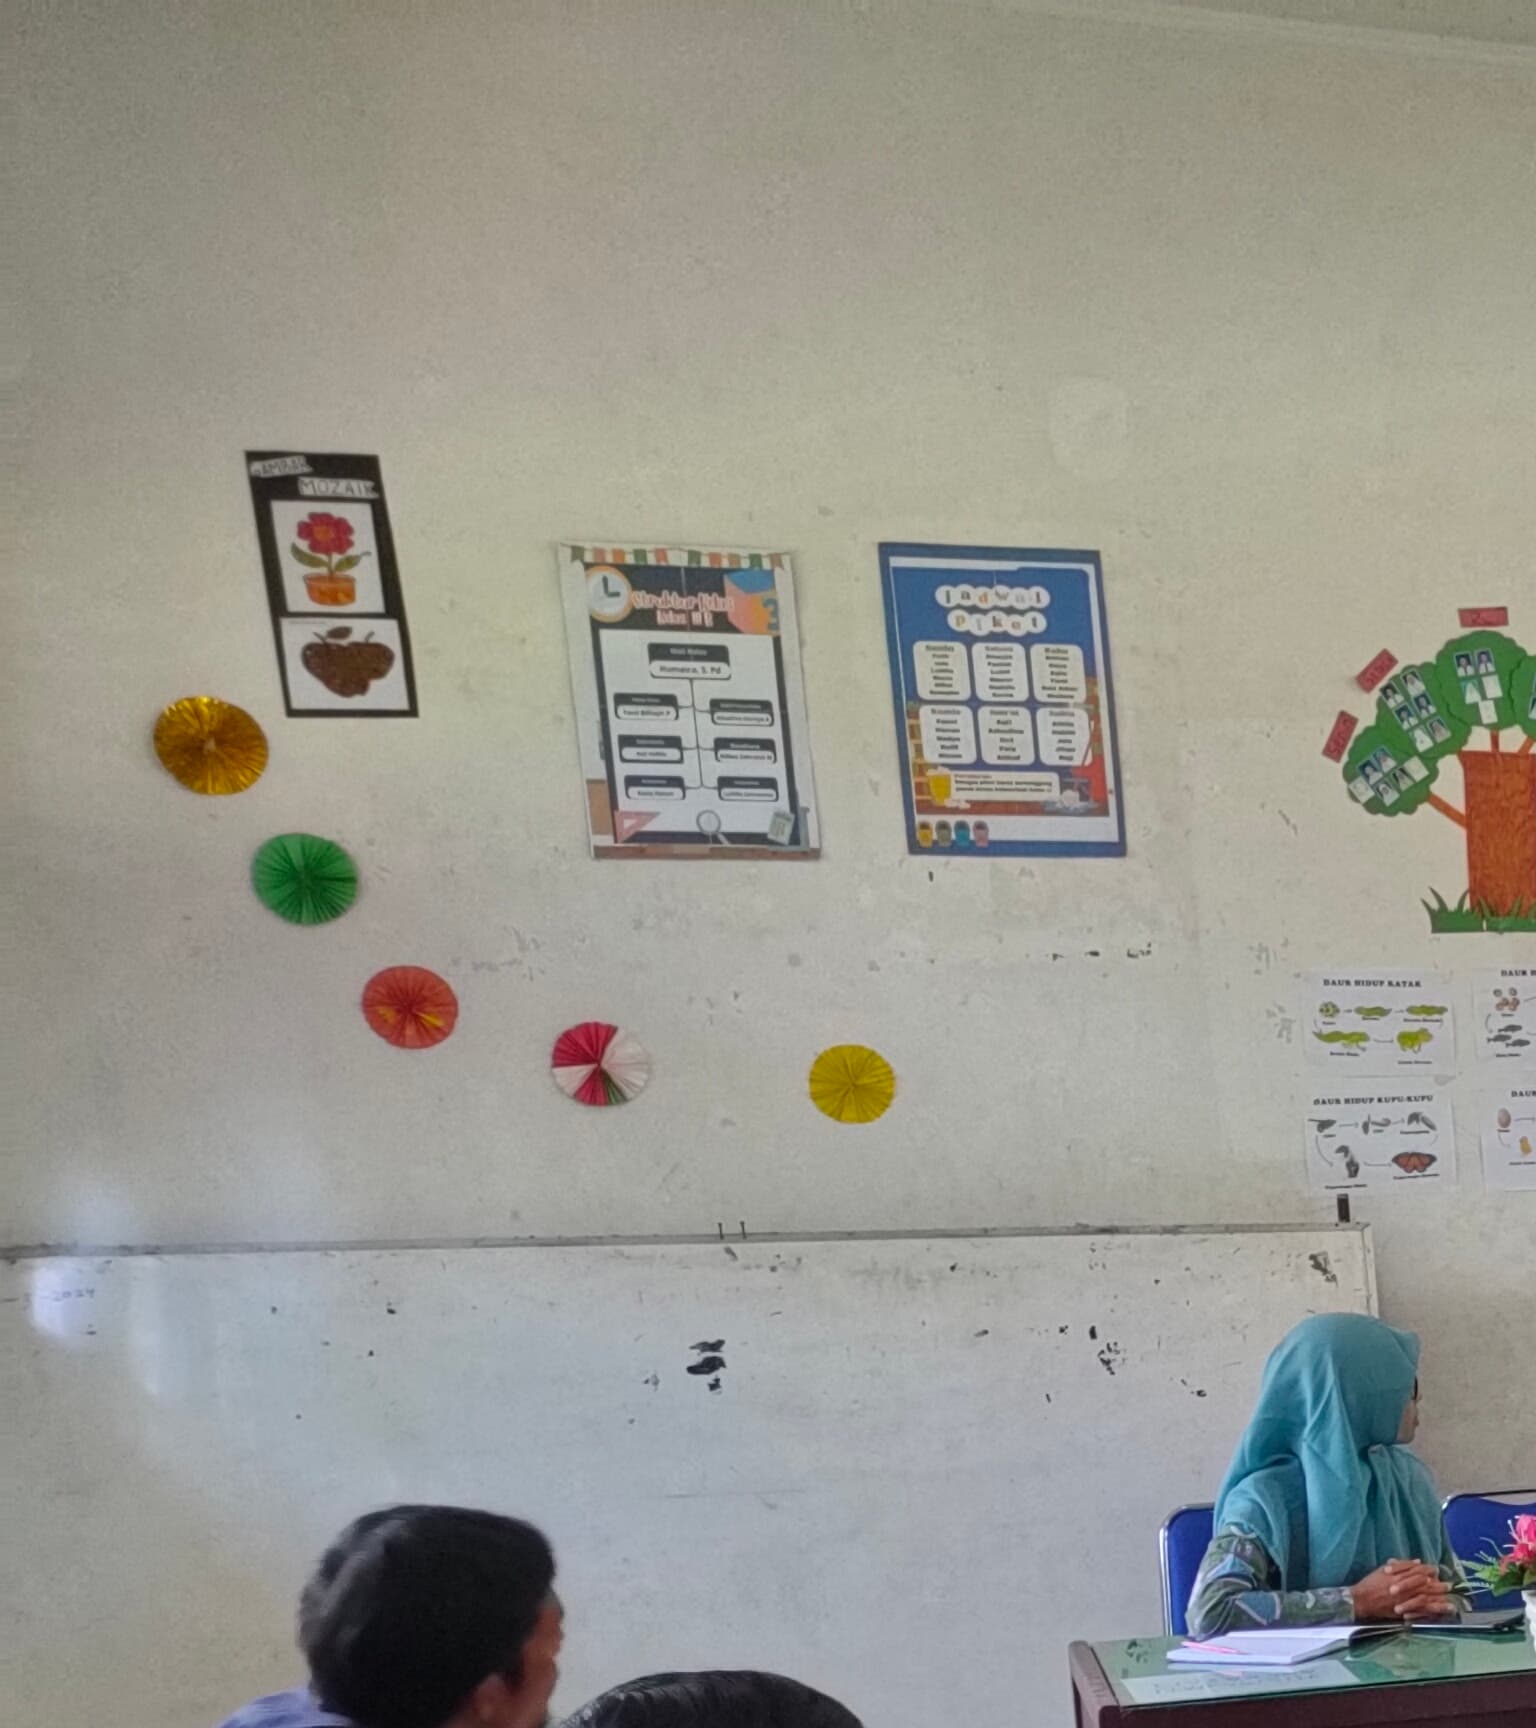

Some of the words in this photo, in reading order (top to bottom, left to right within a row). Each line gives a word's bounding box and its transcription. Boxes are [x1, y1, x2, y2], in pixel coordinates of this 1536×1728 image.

[1500, 969, 1528, 977] DAUR
[1323, 978, 1352, 987] DAUR
[1354, 979, 1386, 988] HIDUP
[1387, 980, 1422, 988] KATAK
[1313, 1097, 1342, 1106] DAUR
[1344, 1096, 1375, 1105] HIDUP
